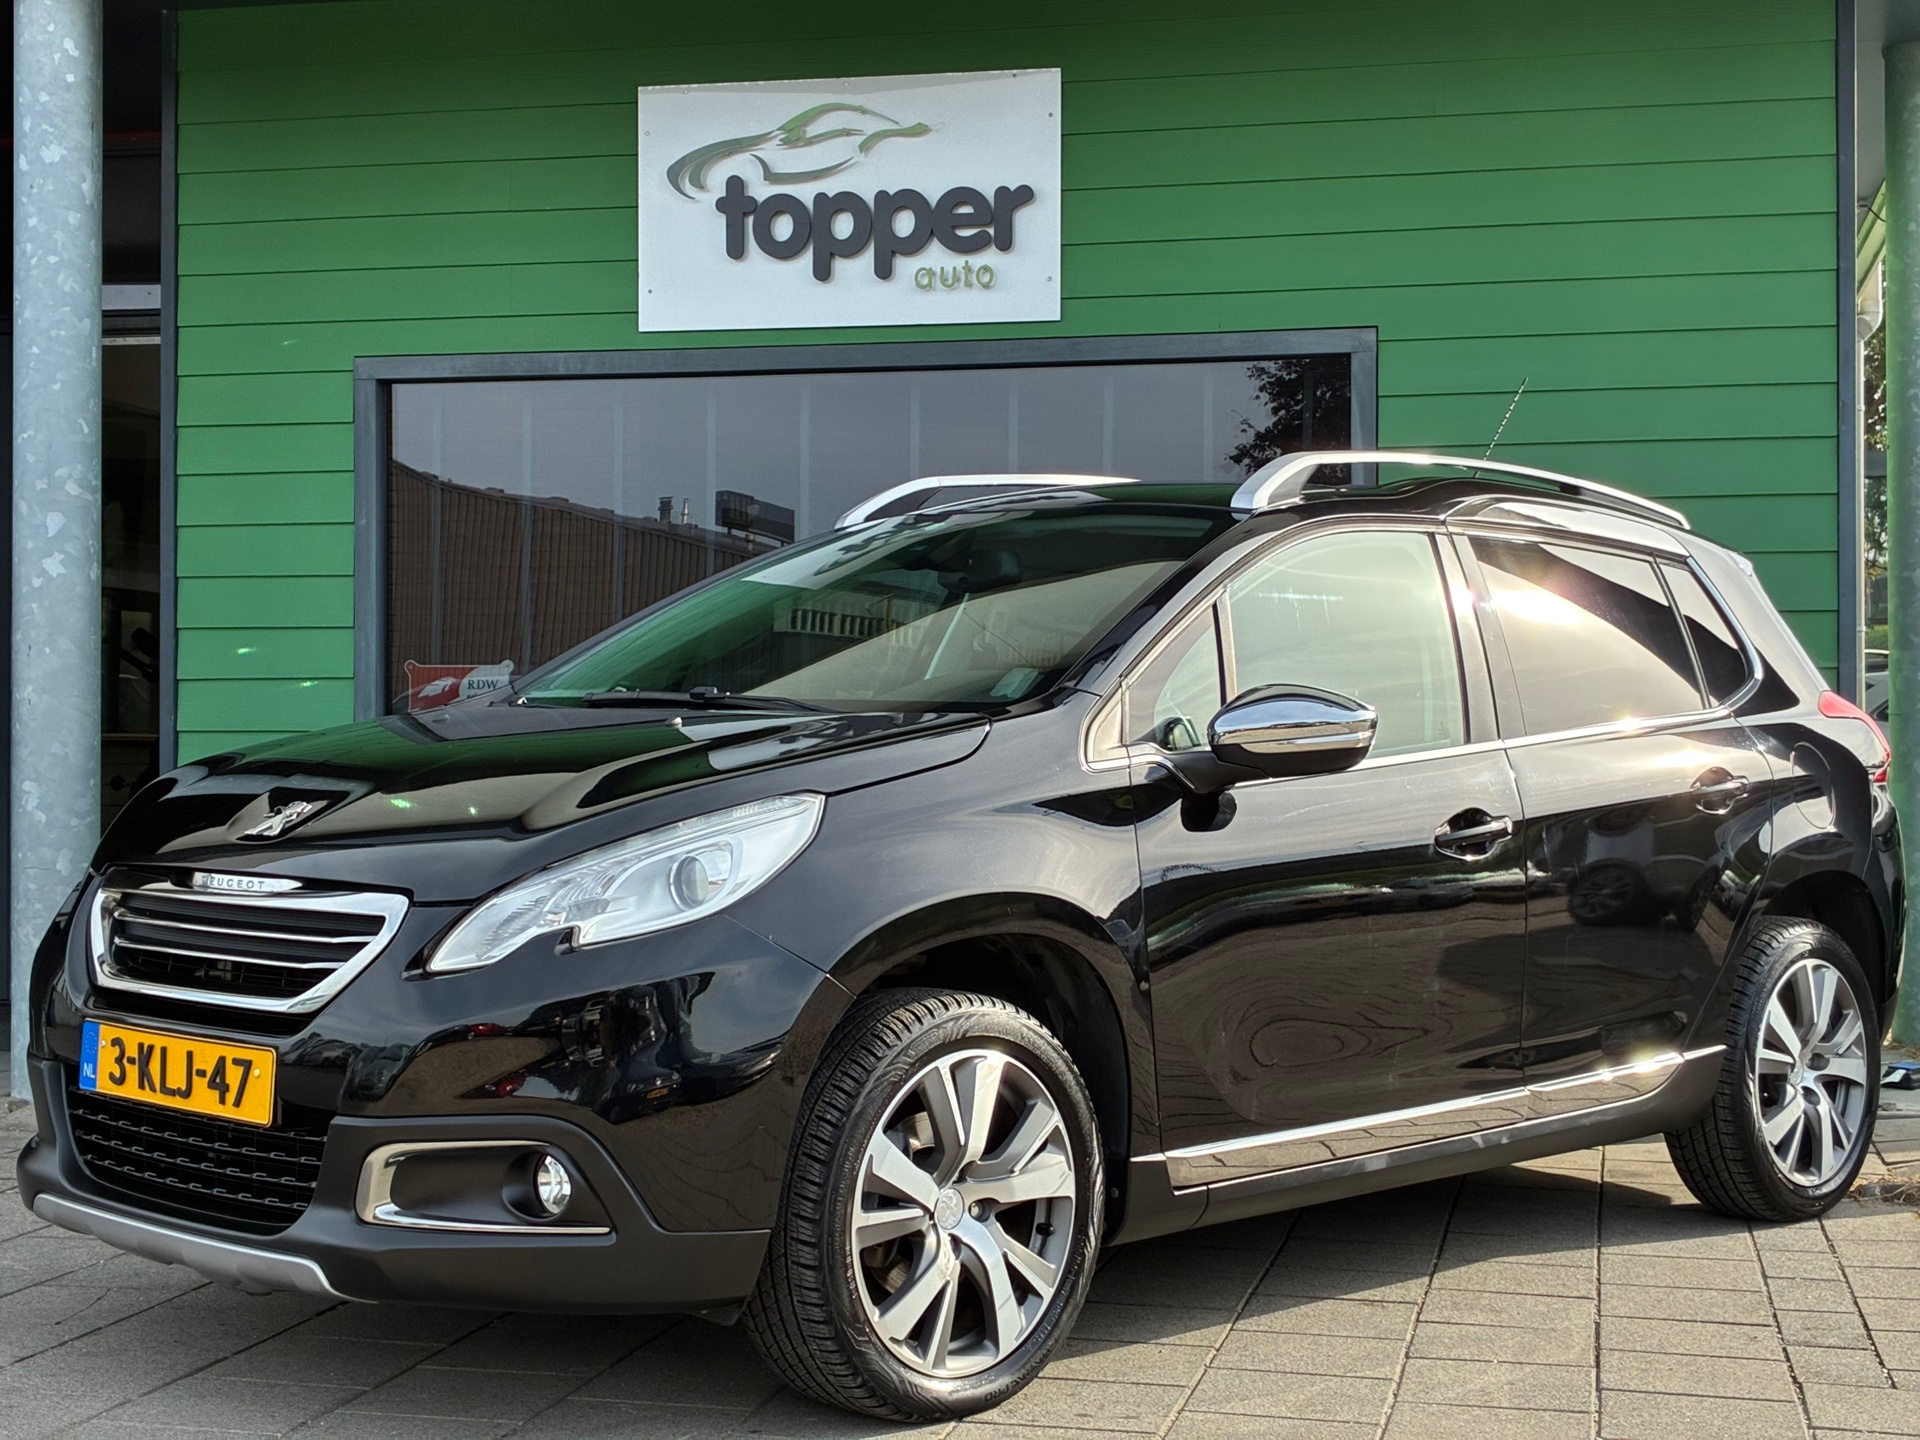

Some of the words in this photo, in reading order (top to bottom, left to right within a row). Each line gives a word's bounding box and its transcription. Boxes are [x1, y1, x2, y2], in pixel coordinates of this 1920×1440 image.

[716, 175, 1034, 281] topper
[914, 260, 994, 288] auto
[467, 679, 499, 690] RDW
[83, 1062, 95, 1079] NL
[108, 1036, 253, 1108] 3-KLJ-47
